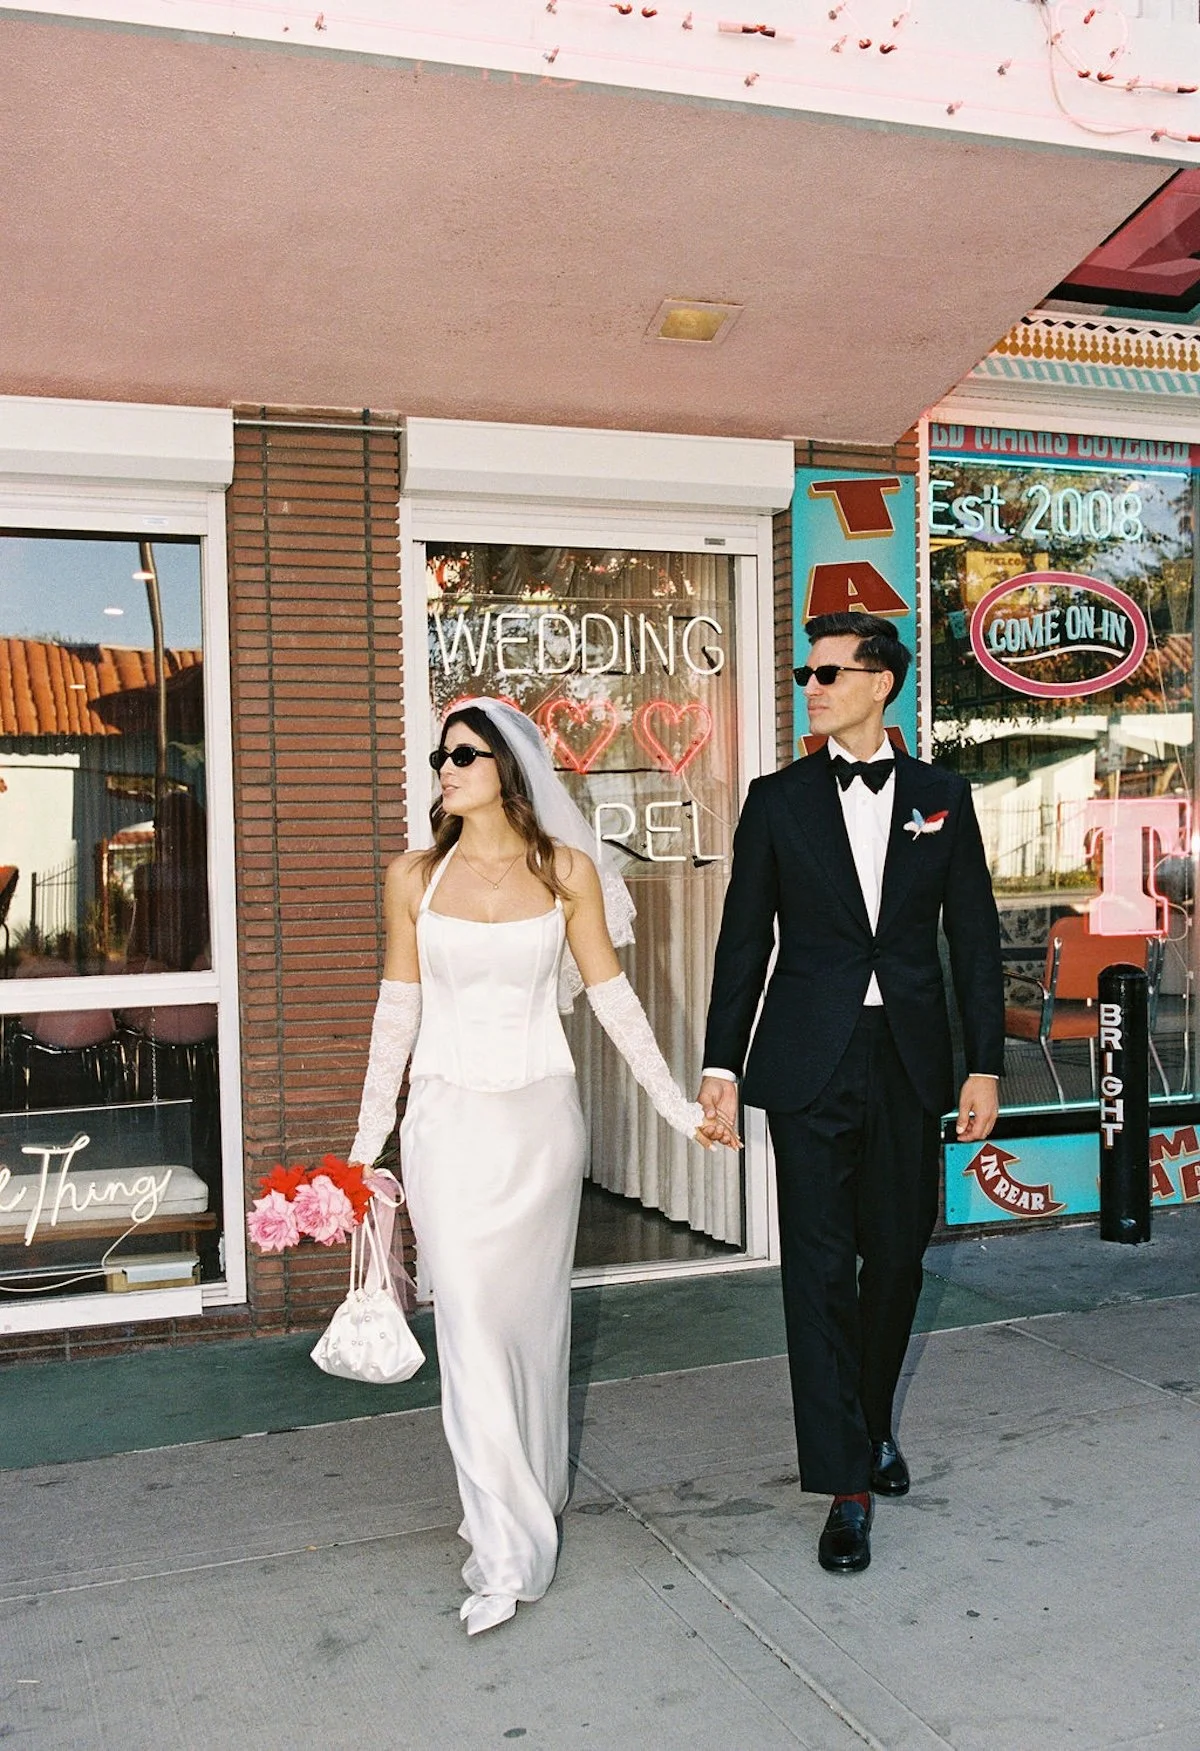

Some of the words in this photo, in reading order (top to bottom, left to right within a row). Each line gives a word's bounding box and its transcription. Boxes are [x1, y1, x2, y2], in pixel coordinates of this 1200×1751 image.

[929, 480, 1016, 535] Est.
[1025, 484, 1143, 541] 2008
[434, 612, 725, 677] WEDDING
[988, 609, 1060, 652] COME
[1065, 605, 1095, 640] ON
[1101, 608, 1127, 648] IN
[1099, 1003, 1125, 1150] BRIGHT
[21, 1133, 173, 1247] Thing
[980, 1153, 1002, 1181] IN
[993, 1176, 1045, 1211] REAR
